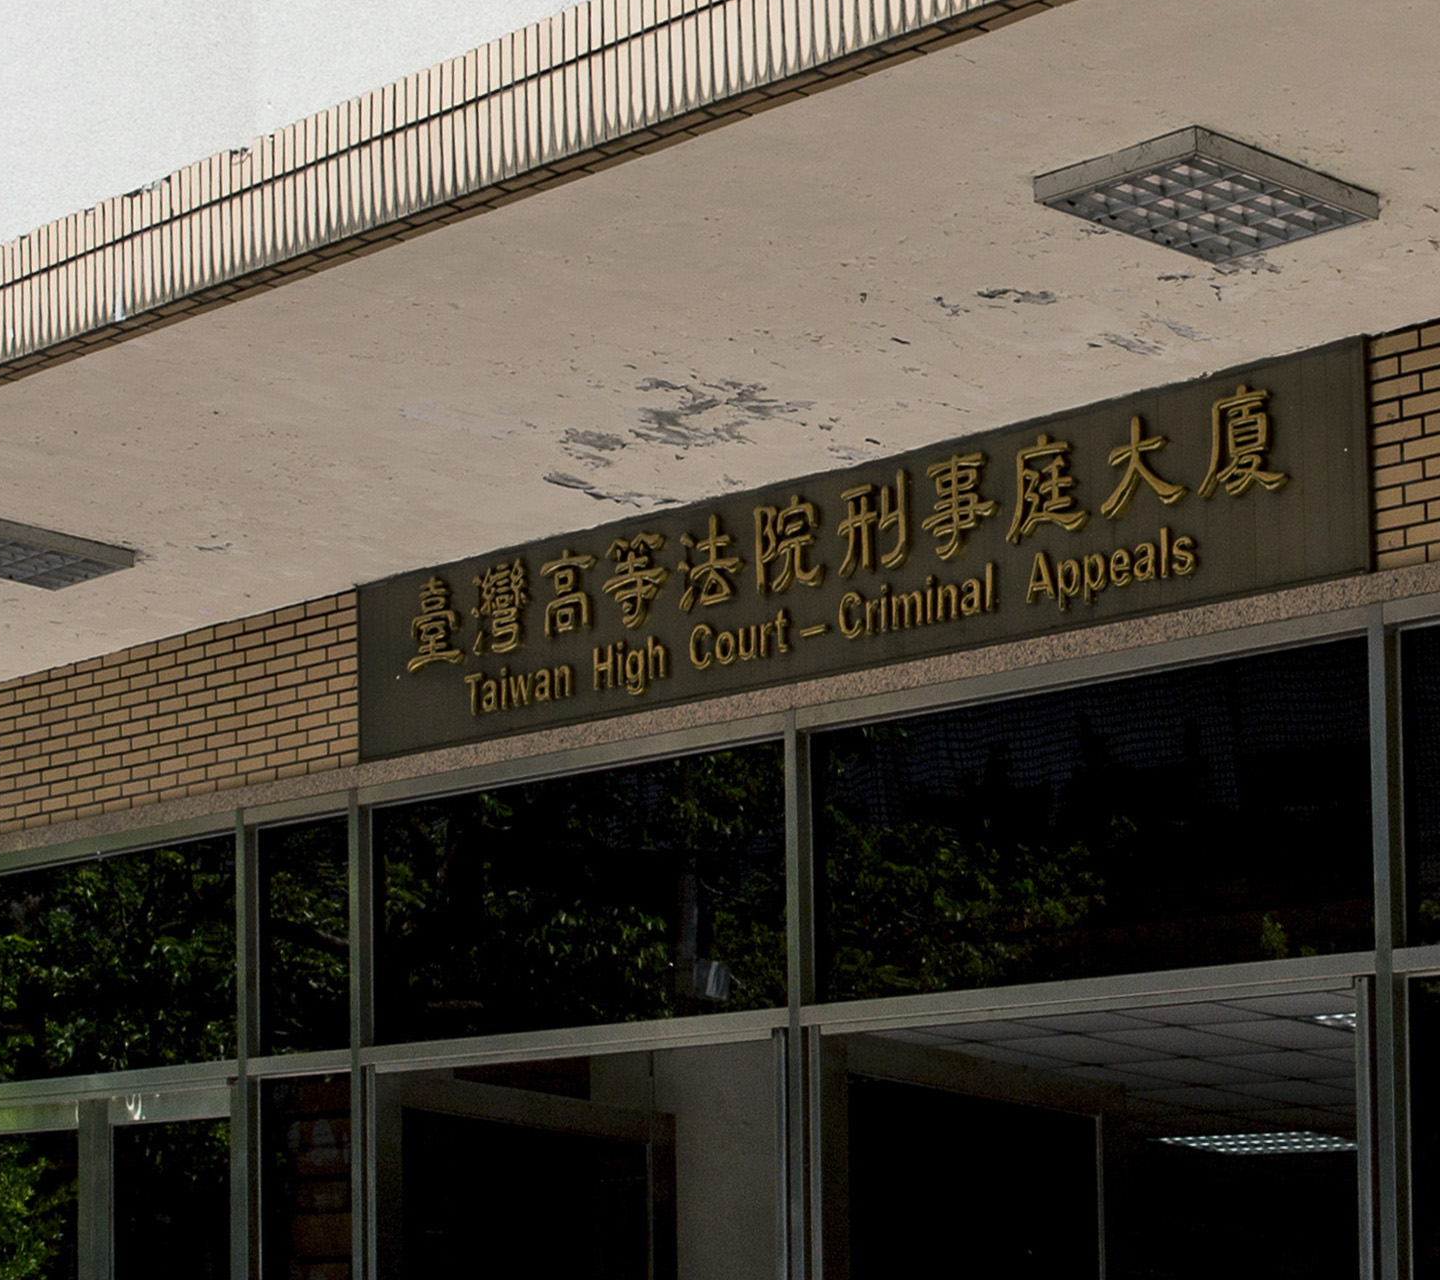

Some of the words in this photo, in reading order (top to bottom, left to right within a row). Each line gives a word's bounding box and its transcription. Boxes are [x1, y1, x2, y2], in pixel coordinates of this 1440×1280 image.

[407, 384, 1288, 673] 臺灣高等法院刑事庭大廈
[464, 664, 575, 717] Taiwan
[592, 636, 667, 696] High
[689, 609, 791, 670] Court
[837, 563, 997, 640] Criminal
[1026, 527, 1198, 612] Appeals
